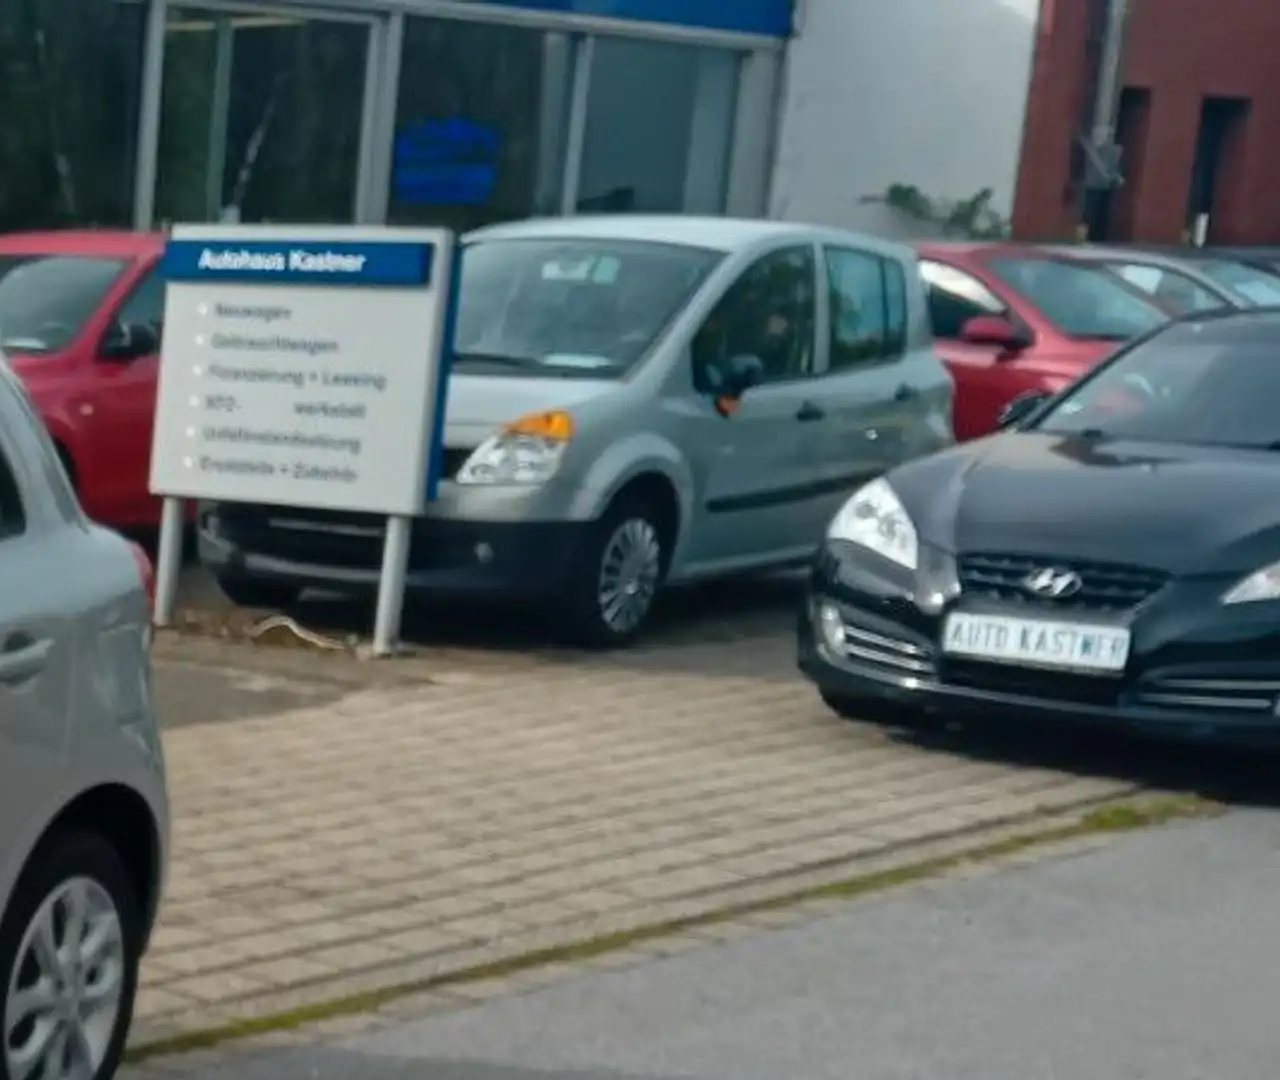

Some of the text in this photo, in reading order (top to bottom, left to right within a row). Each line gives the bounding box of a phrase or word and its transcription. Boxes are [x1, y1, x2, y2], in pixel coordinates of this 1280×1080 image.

[198, 249, 366, 271] Autohaus Kastner
[951, 621, 1126, 659] AUTO KASTNER
